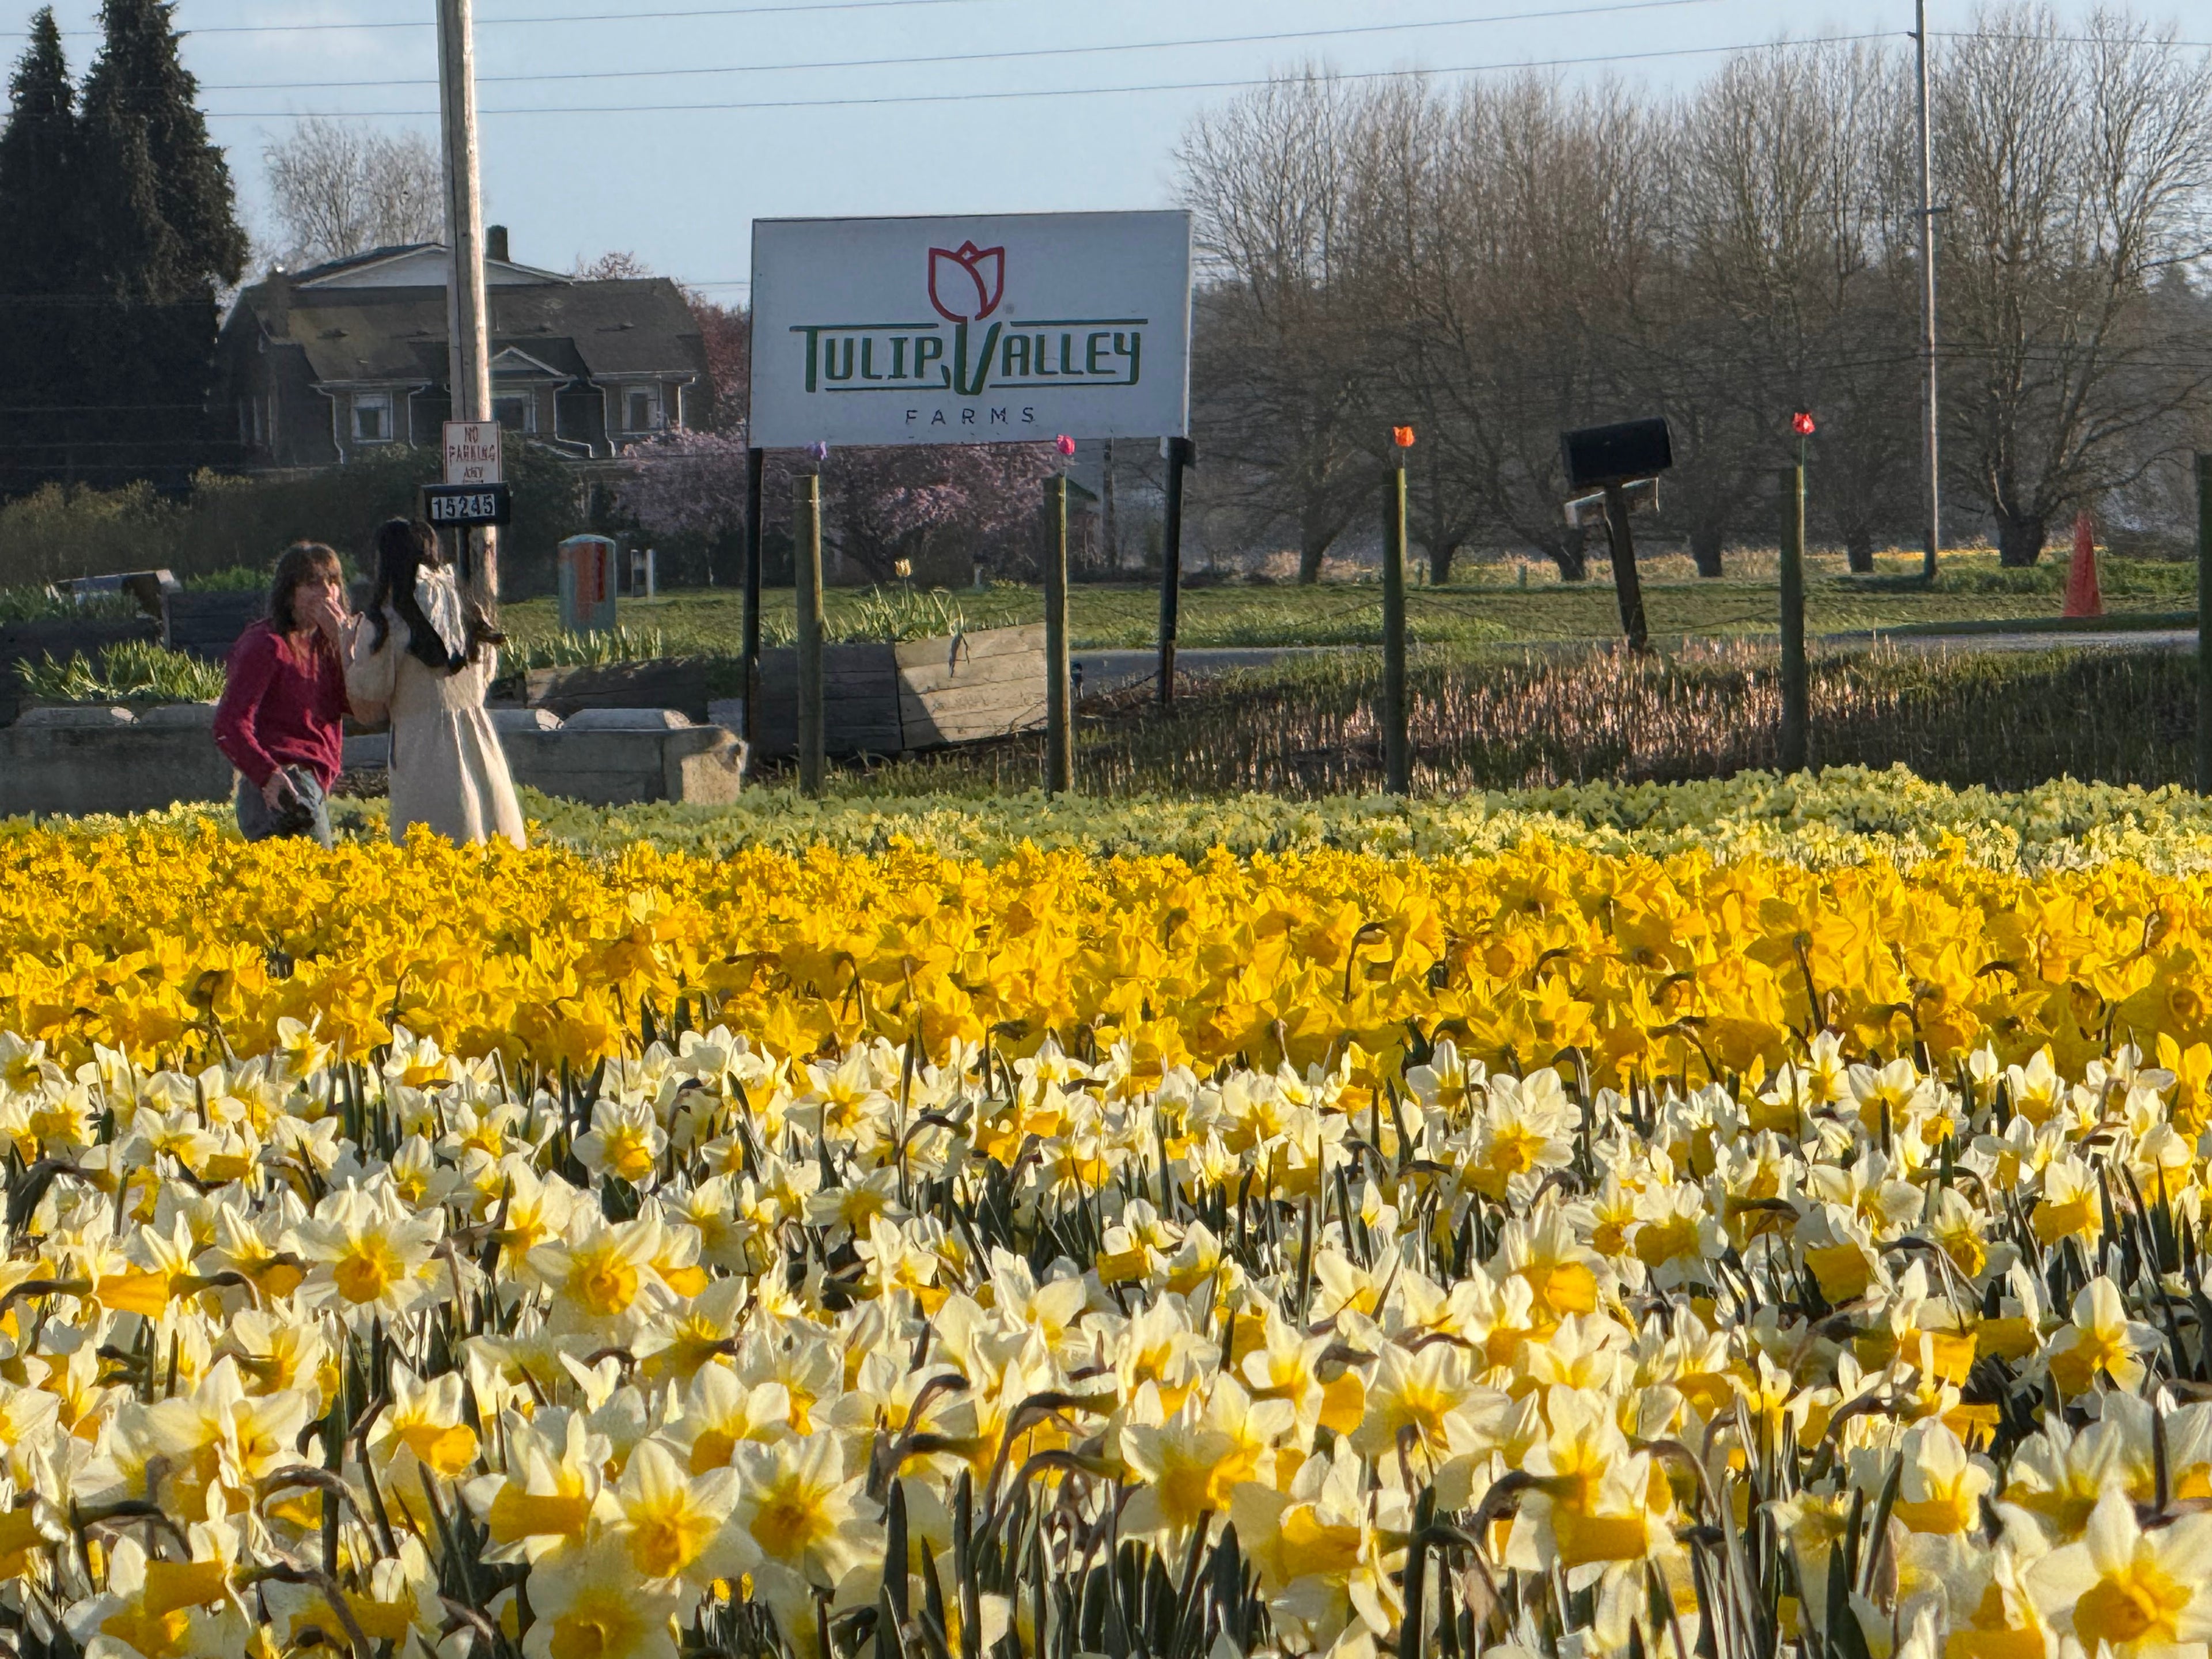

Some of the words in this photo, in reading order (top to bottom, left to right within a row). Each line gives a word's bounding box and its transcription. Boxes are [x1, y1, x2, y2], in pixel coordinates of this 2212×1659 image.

[789, 323, 950, 393] TULIP
[955, 319, 1149, 396] VALLEY
[905, 406, 1035, 425] FARMS
[464, 426, 479, 443] NO
[449, 444, 495, 462] PARKING
[433, 494, 494, 518] 15245
